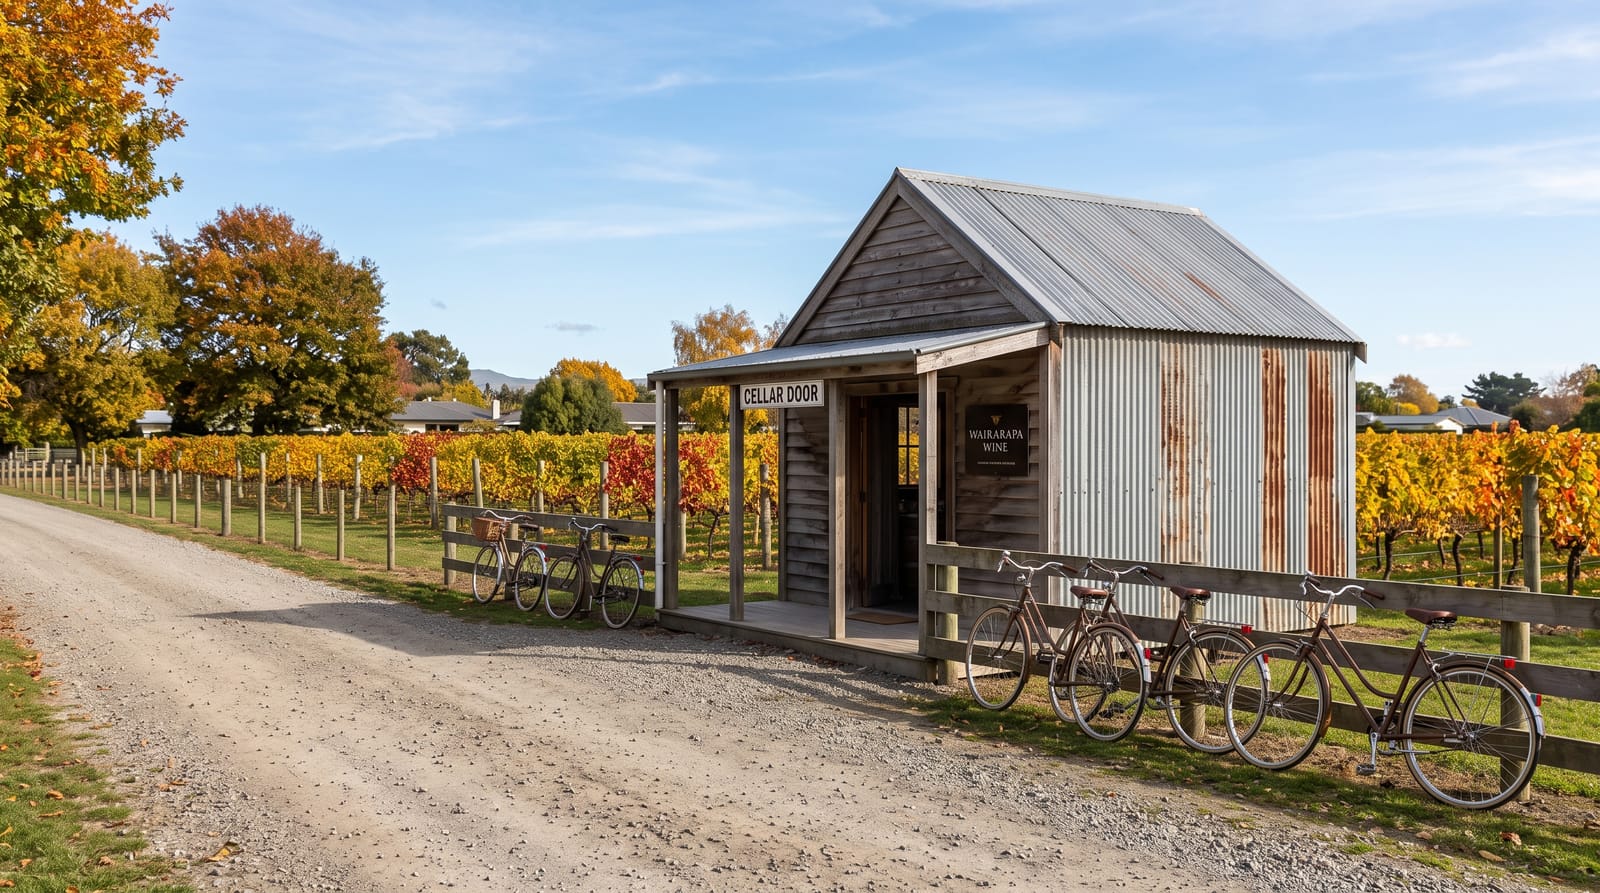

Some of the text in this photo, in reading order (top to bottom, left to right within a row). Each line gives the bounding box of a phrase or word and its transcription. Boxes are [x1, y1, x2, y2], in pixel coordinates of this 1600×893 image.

[744, 384, 818, 404] CELLAR DOOR
[969, 429, 1023, 440] WAIRARAPA
[983, 442, 1008, 452] WINE
